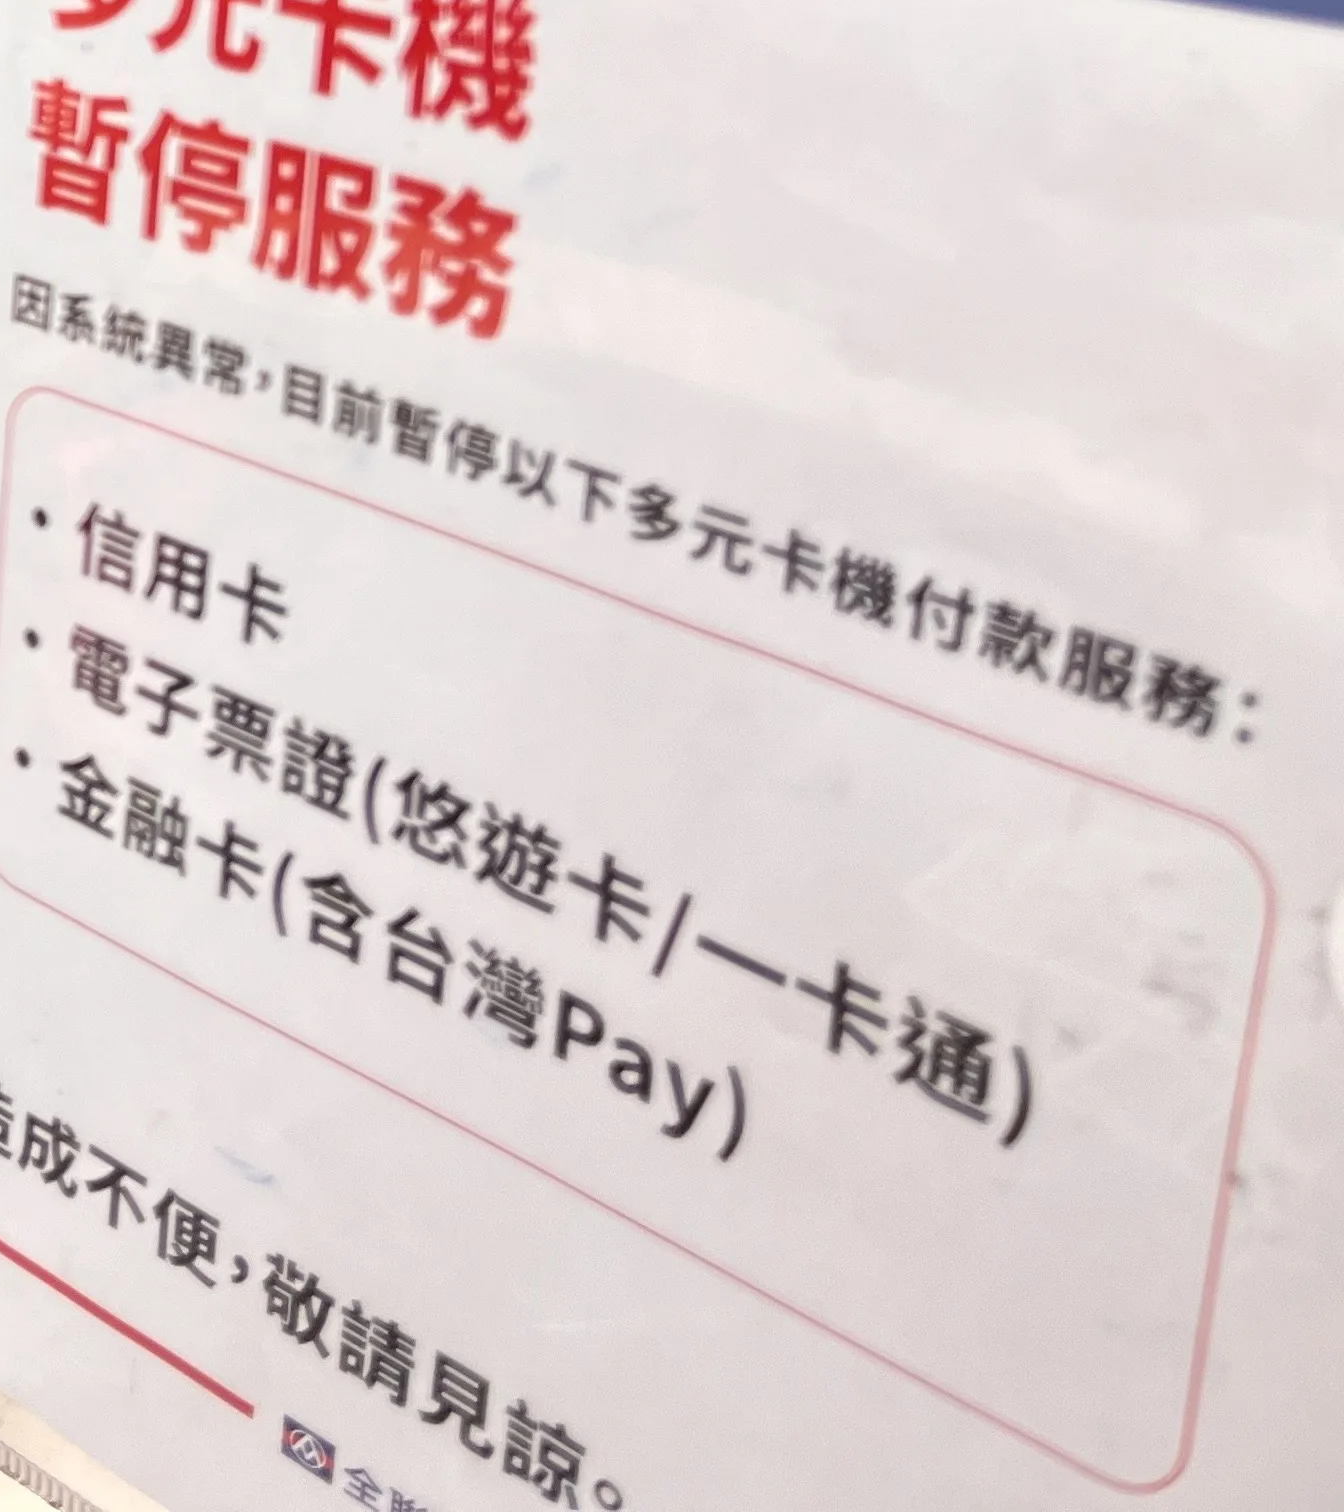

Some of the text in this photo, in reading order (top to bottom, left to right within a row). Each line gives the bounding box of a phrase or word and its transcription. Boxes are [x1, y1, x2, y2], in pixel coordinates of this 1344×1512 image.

[29, 78, 522, 342] 暫停服務
[74, 501, 293, 646] 信用卡
[57, 748, 748, 1163] 金融卡(含台灣Pay)
[63, 620, 1039, 1152] 電子票證(悠遊卡/一卡通)
